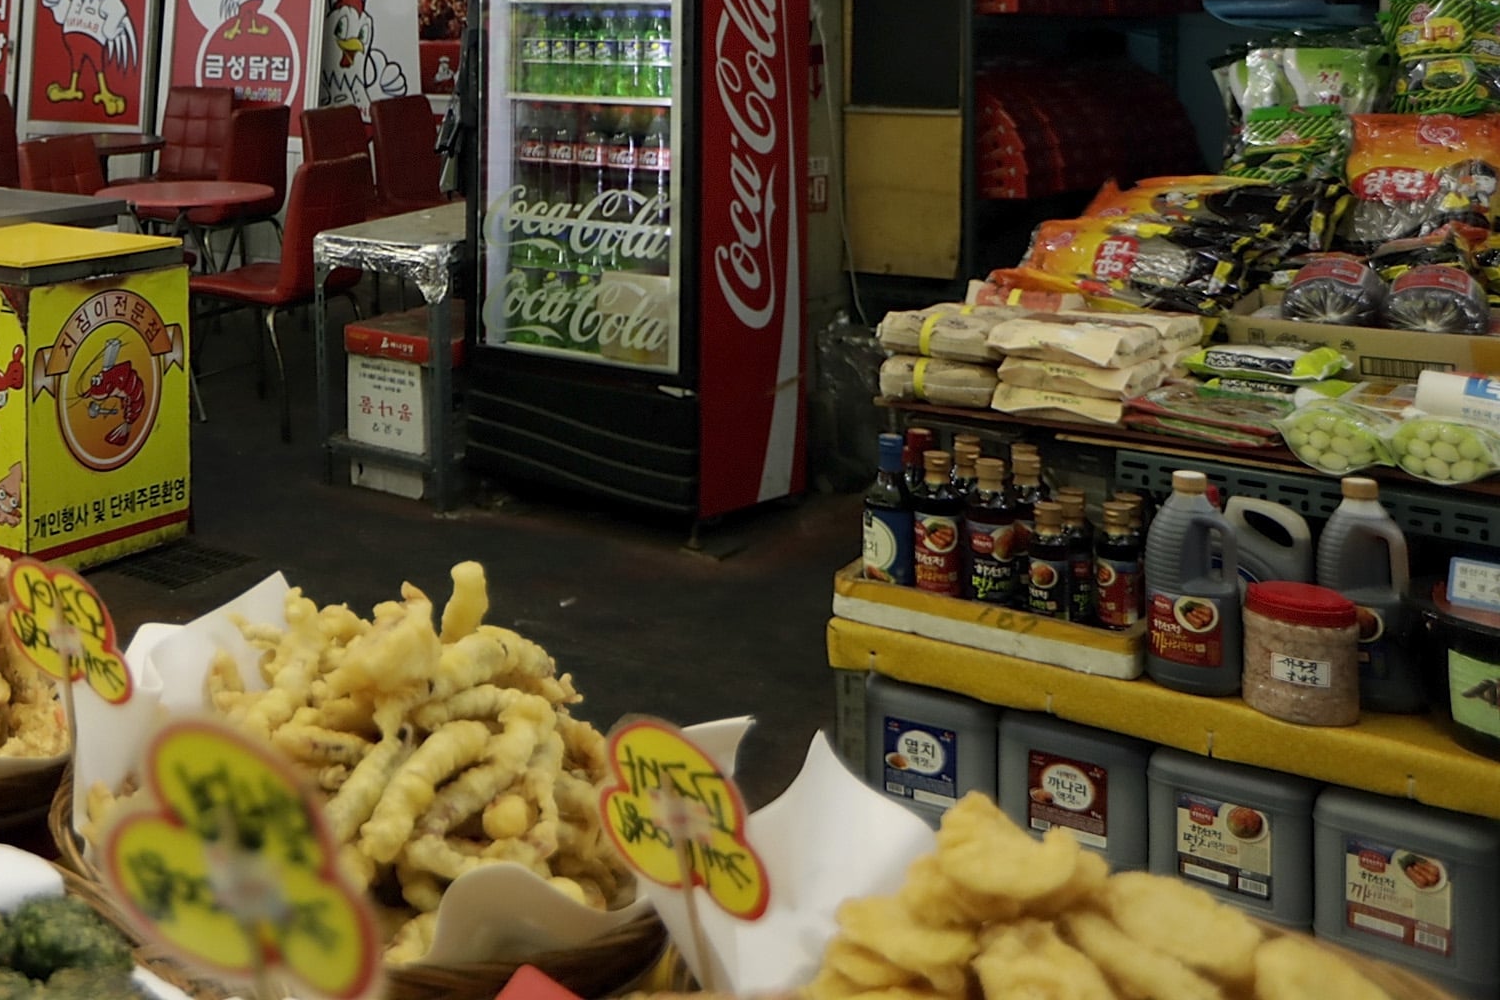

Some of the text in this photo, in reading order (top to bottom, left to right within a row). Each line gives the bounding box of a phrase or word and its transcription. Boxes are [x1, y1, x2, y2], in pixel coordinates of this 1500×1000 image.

[205, 54, 290, 81] 금성닭집
[483, 184, 671, 259] Coca-Cola
[60, 295, 162, 357] 지짐이전문점
[482, 271, 671, 350] Coca-Cola
[33, 477, 186, 538] 개인행사 및 단체주문환영
[904, 738, 936, 759] 멸치
[1047, 776, 1088, 797] 까나리
